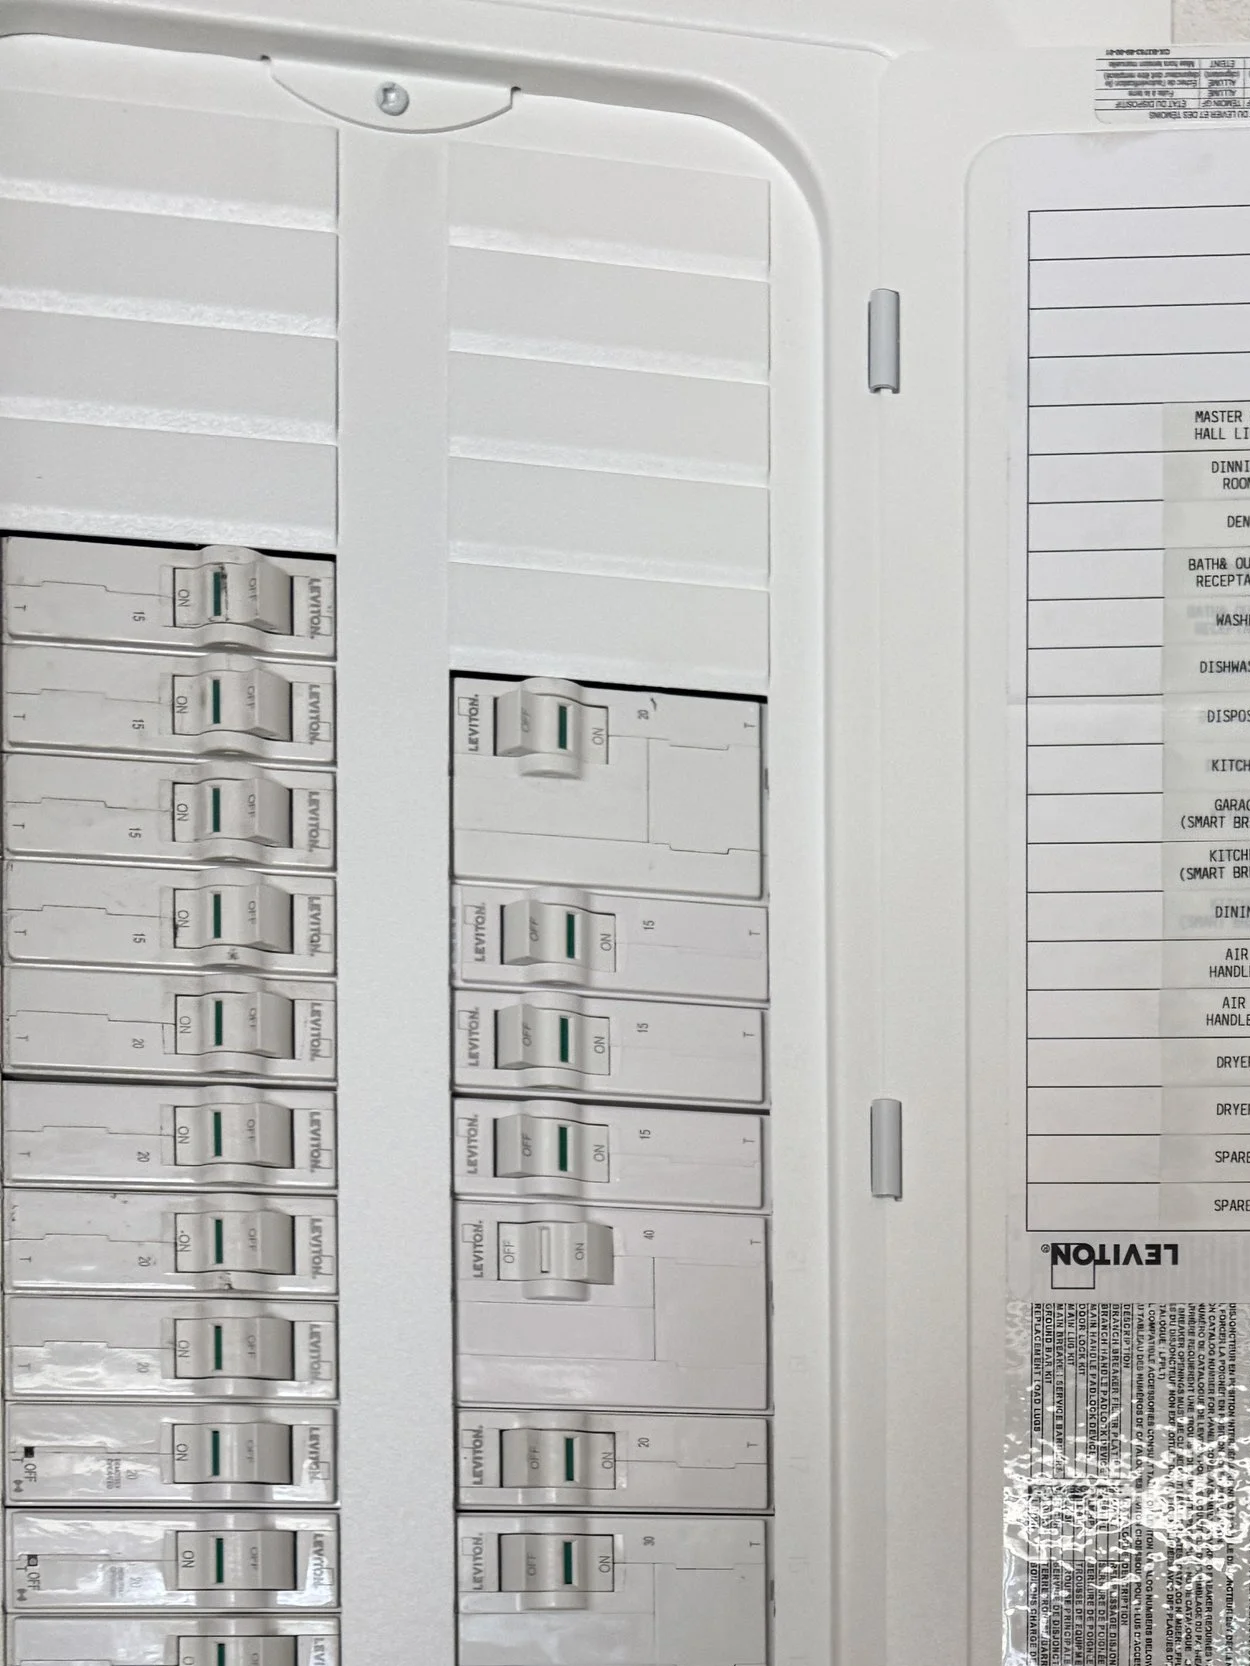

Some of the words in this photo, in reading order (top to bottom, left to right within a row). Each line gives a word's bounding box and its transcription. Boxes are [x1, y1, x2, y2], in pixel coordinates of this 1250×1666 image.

[1195, 410, 1243, 423] MASTER
[1194, 427, 1227, 441] HALL
[1227, 515, 1250, 528] DEN
[1188, 557, 1228, 571] BATH&
[177, 588, 191, 608] ON
[132, 611, 146, 622] 15
[1180, 815, 1226, 830] (SMART
[1179, 866, 1226, 882] (SMART
[530, 916, 540, 942] OFF
[642, 920, 654, 930] 15
[600, 933, 612, 952] ON
[1225, 947, 1249, 961] AIR
[1222, 996, 1246, 1010] AIR
[642, 1229, 655, 1240] 40
[503, 1241, 514, 1263] OFF
[1033, 1408, 1042, 1432] LUGS
[637, 1437, 650, 1448] 20
[24, 1463, 37, 1483] OFF
